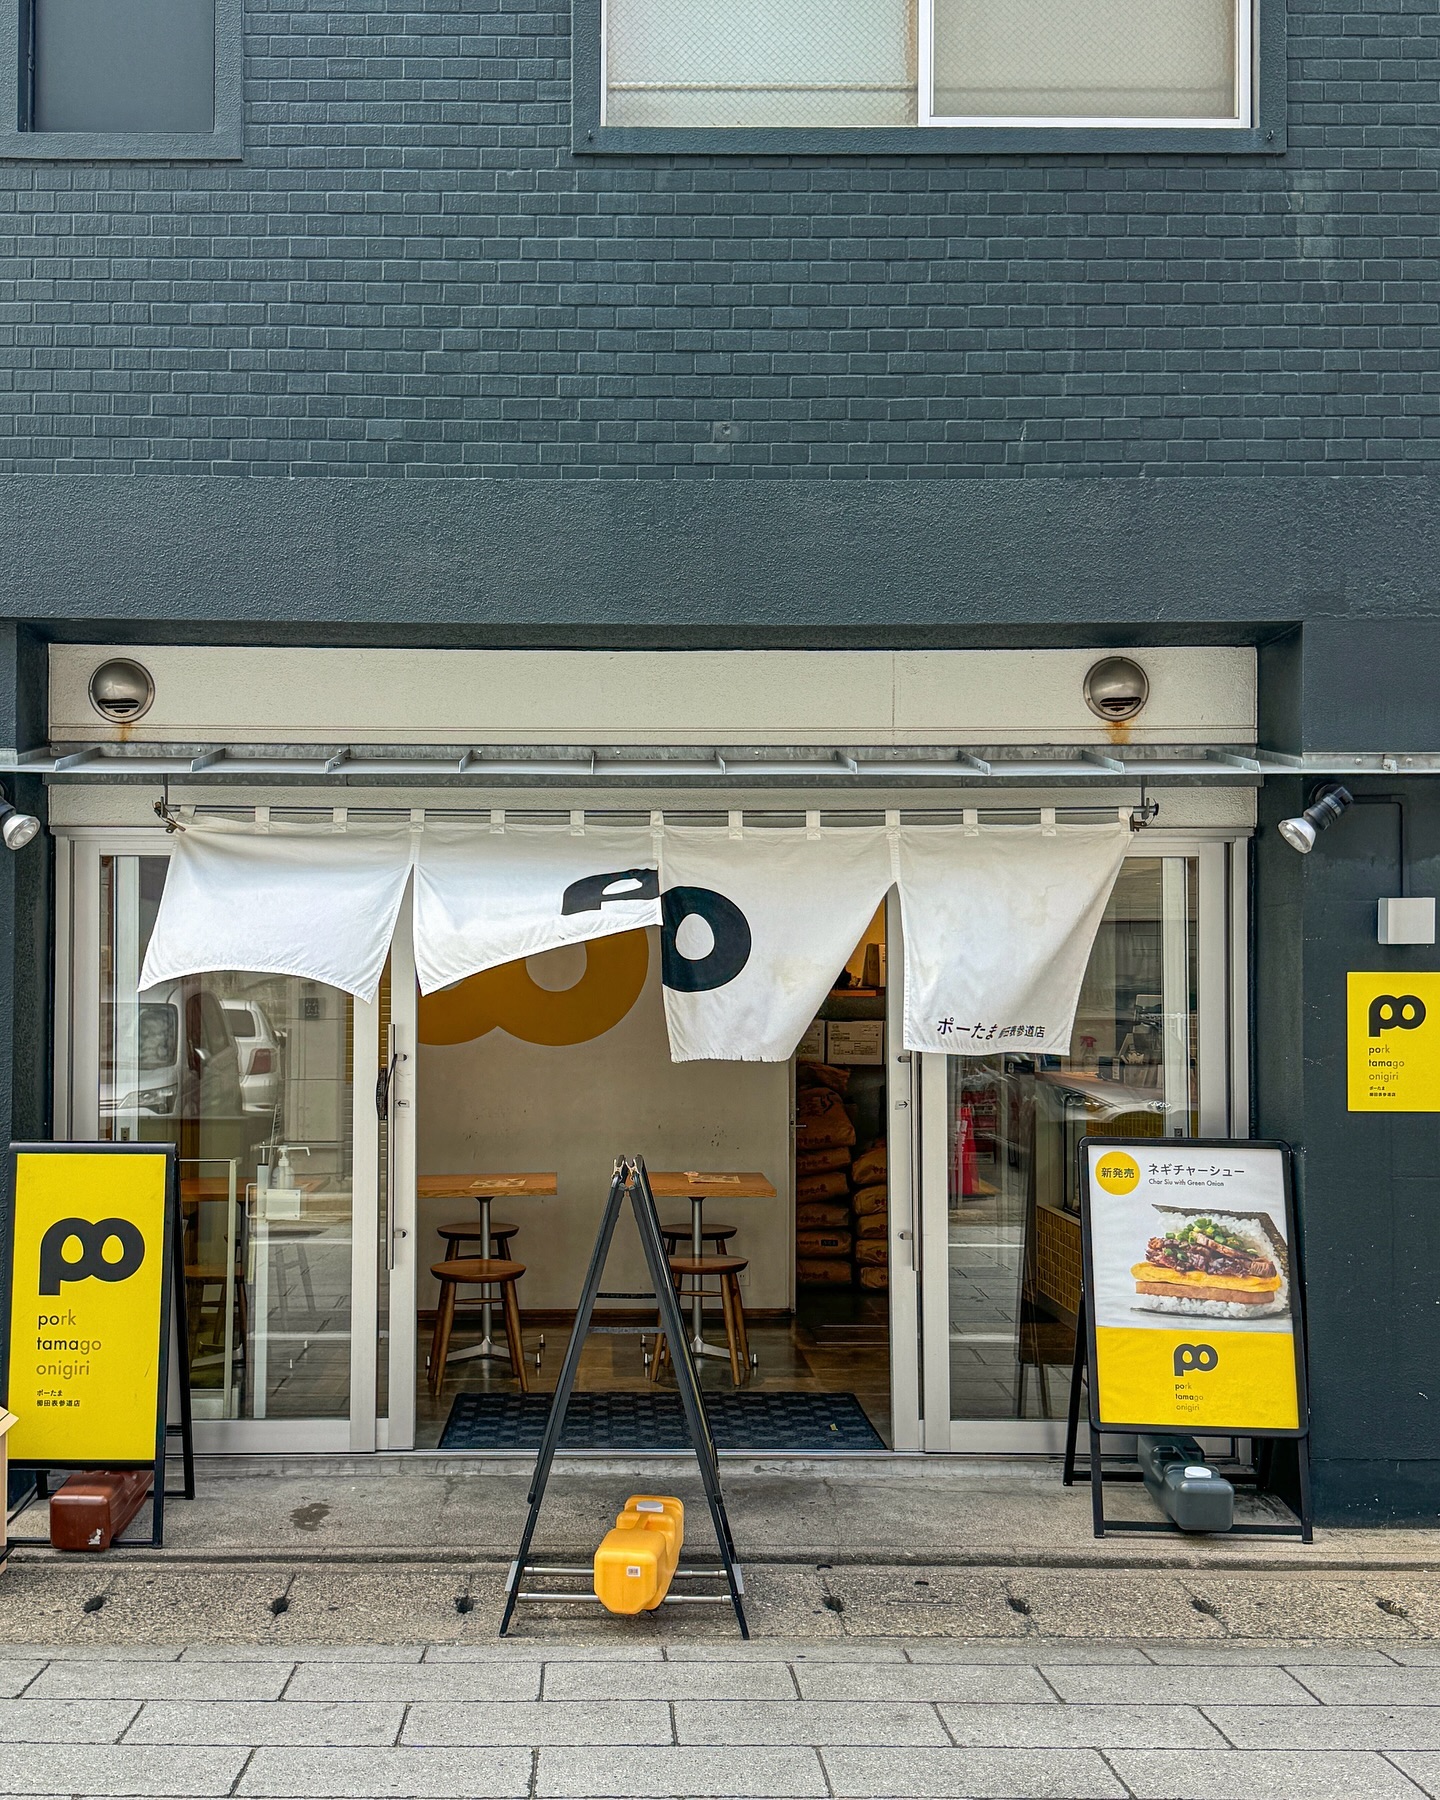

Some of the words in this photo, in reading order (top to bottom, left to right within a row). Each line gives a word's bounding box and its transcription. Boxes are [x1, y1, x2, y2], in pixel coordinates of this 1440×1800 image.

[937, 1017, 998, 1040] ポーたま
[1368, 1045, 1390, 1055] pork
[1368, 1059, 1405, 1069] tamago
[1369, 1072, 1399, 1082] onigiri
[1101, 1167, 1135, 1179] 新発売
[1148, 1163, 1245, 1177] ネギチャーシュー
[38, 1309, 77, 1330] pork
[37, 1337, 102, 1355] tamago
[36, 1360, 90, 1379] onigiri
[1175, 1382, 1192, 1391] pork
[36, 1389, 63, 1397] ポーたま
[1175, 1393, 1204, 1402] tamago
[1176, 1403, 1200, 1412] onigiri
